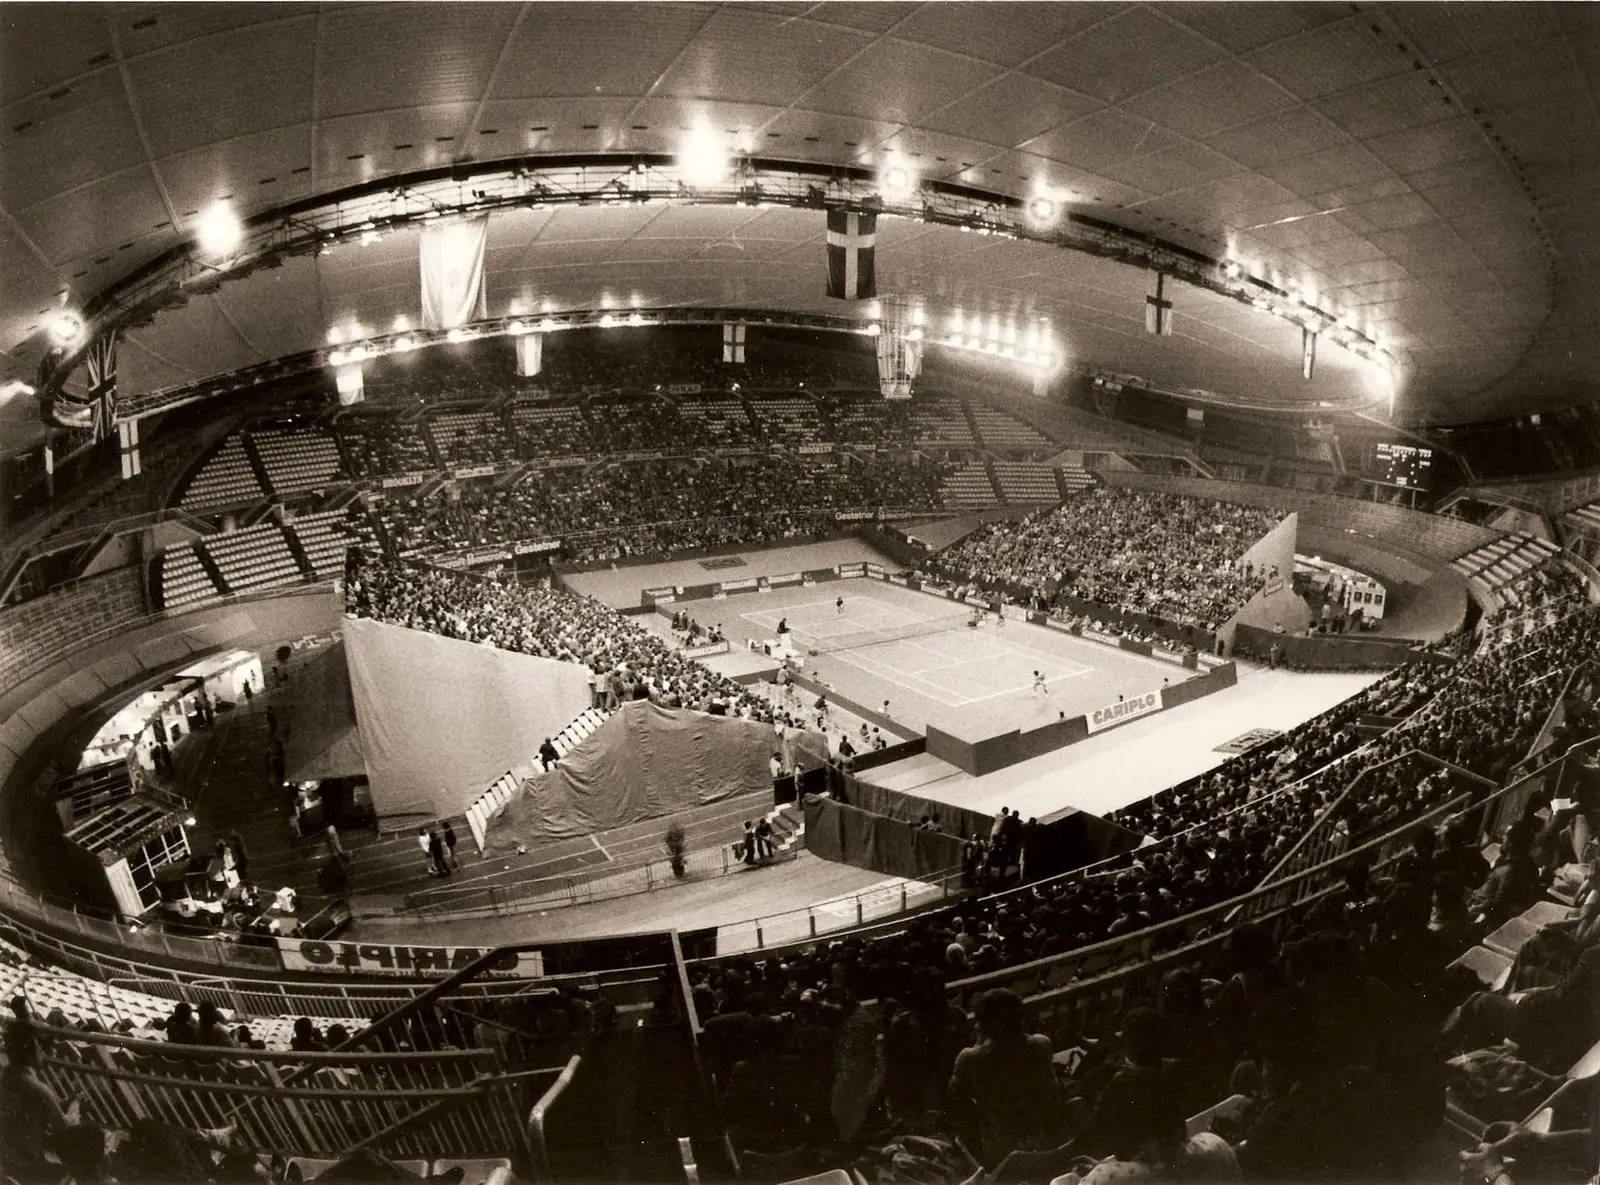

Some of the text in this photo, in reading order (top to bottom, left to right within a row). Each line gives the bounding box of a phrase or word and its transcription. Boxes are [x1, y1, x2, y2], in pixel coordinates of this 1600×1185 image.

[835, 511, 874, 520] Gestetner
[514, 540, 561, 555] Gestetner
[1093, 693, 1156, 725] CARIPLO
